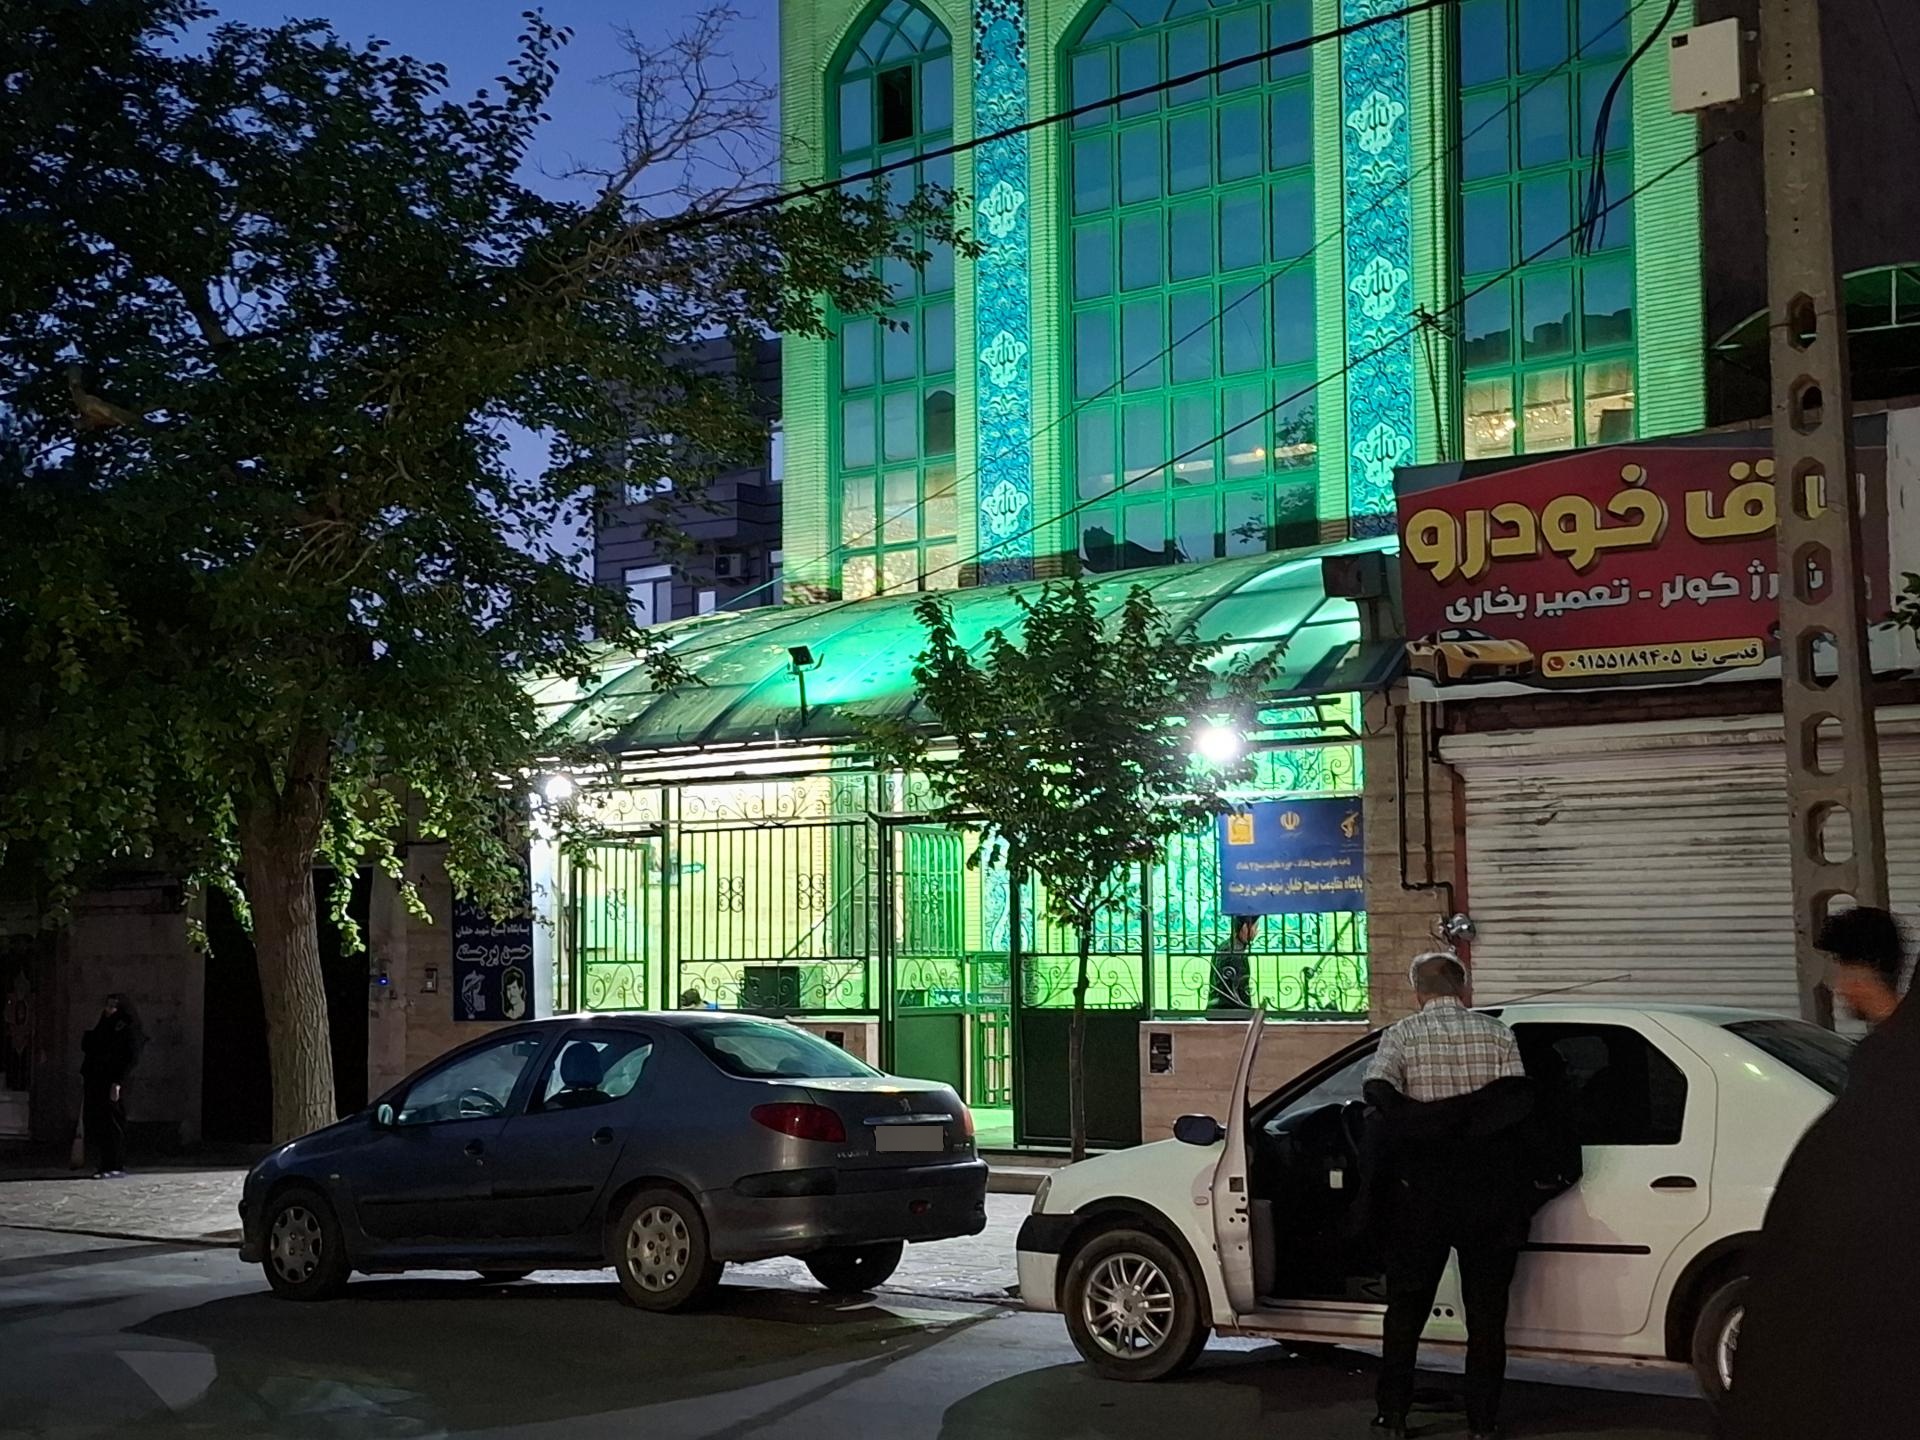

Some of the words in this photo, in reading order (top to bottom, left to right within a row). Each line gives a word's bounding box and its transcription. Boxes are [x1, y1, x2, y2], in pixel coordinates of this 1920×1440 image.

[1405, 464, 1668, 582] خودرو
[1445, 585, 1528, 622] بخاری
[1534, 578, 1631, 617] تعمیر
[1659, 572, 1740, 608] کولر
[1569, 649, 1682, 670] ۰۹۱۵۵۱۸۹۴۰۵
[1691, 648, 1708, 666] نیا
[1712, 643, 1760, 665] قدسی
